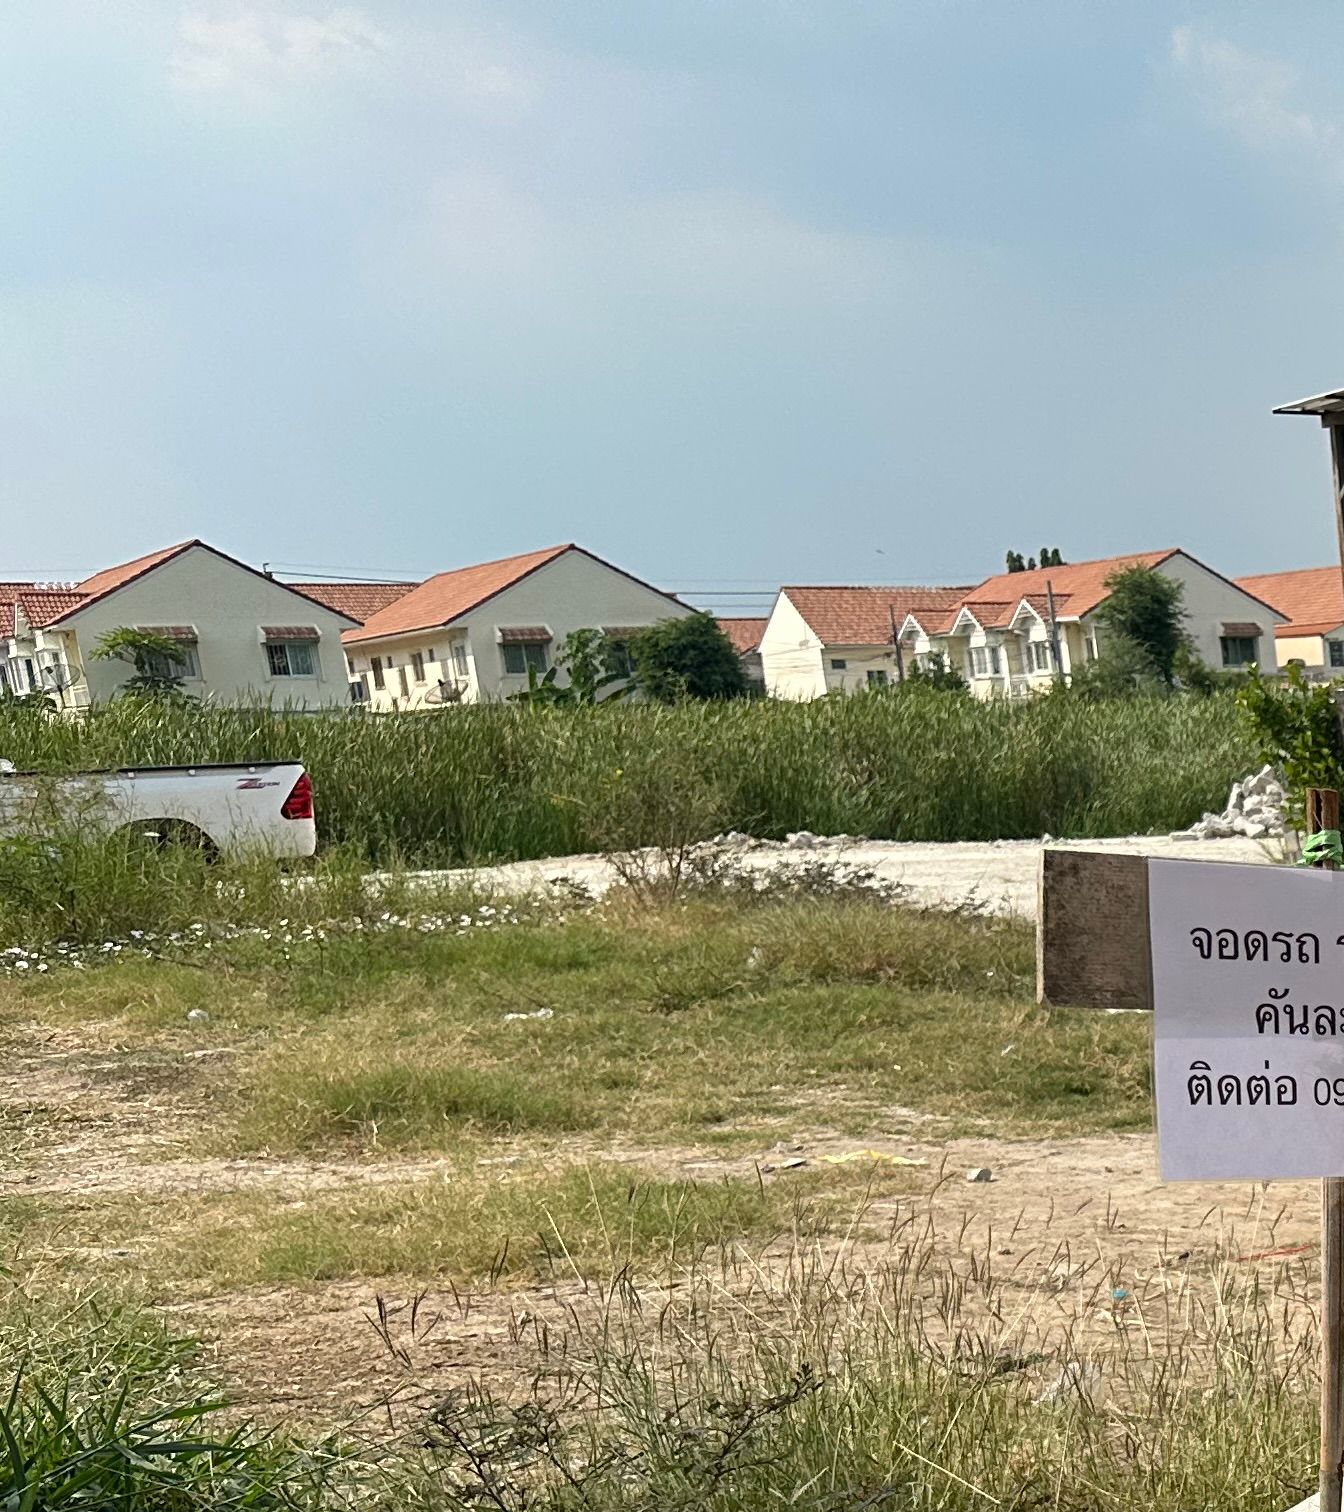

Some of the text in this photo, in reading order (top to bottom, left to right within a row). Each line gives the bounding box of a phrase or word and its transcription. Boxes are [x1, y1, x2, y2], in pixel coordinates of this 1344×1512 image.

[1189, 926, 1320, 964] จอดรถ
[1187, 1059, 1298, 1106] ติดต่อ
